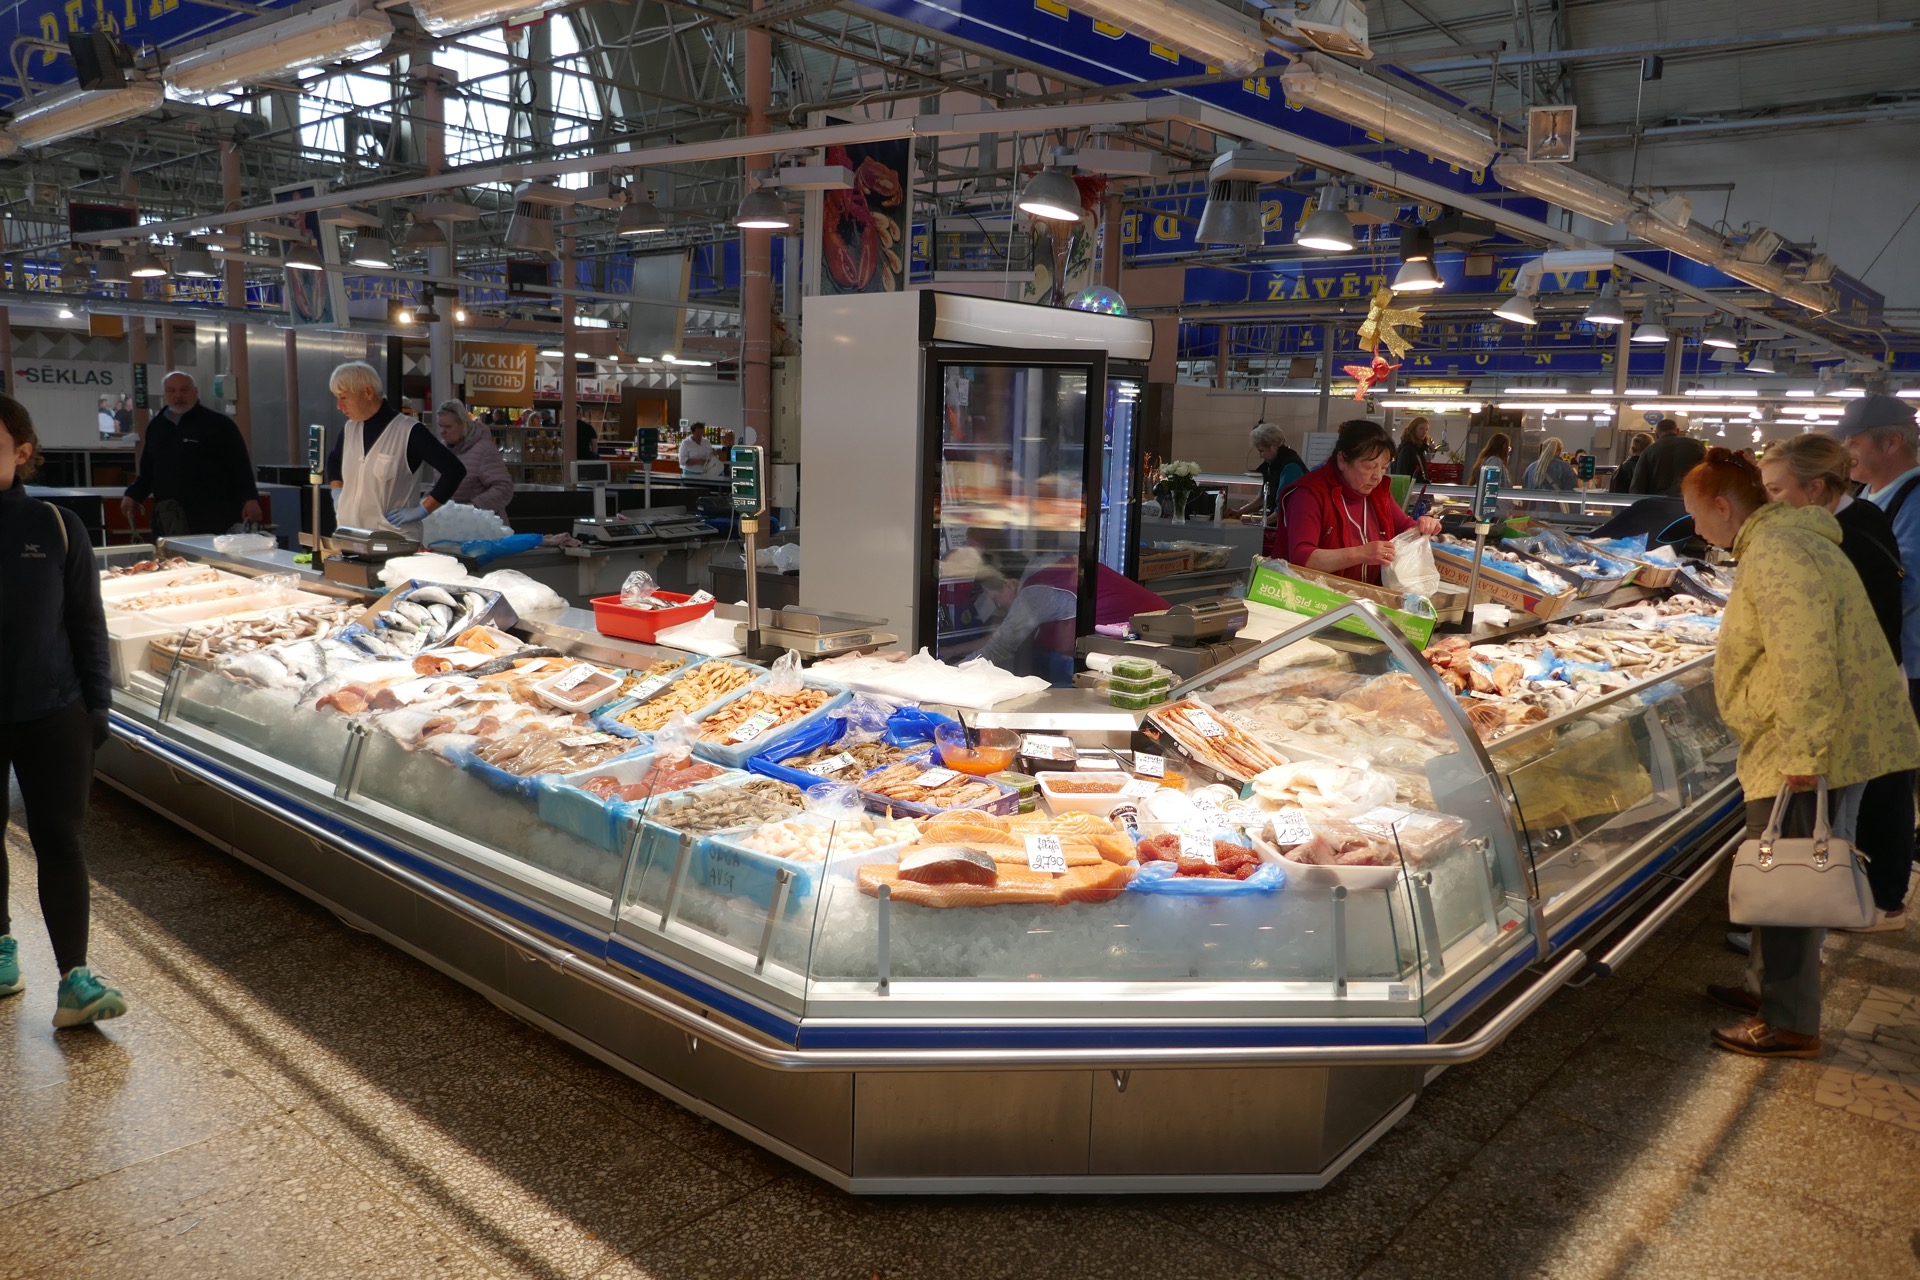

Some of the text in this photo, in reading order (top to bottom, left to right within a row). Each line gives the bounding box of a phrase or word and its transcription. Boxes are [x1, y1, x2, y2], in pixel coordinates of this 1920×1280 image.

[40, 0, 179, 66] DELI
[26, 365, 113, 385] SĒKLAS
[1458, 573, 1470, 584] DA
[1259, 583, 1312, 608] PISATOR
[1314, 601, 1328, 611] B/F.
[1031, 854, 1065, 869] 2790
